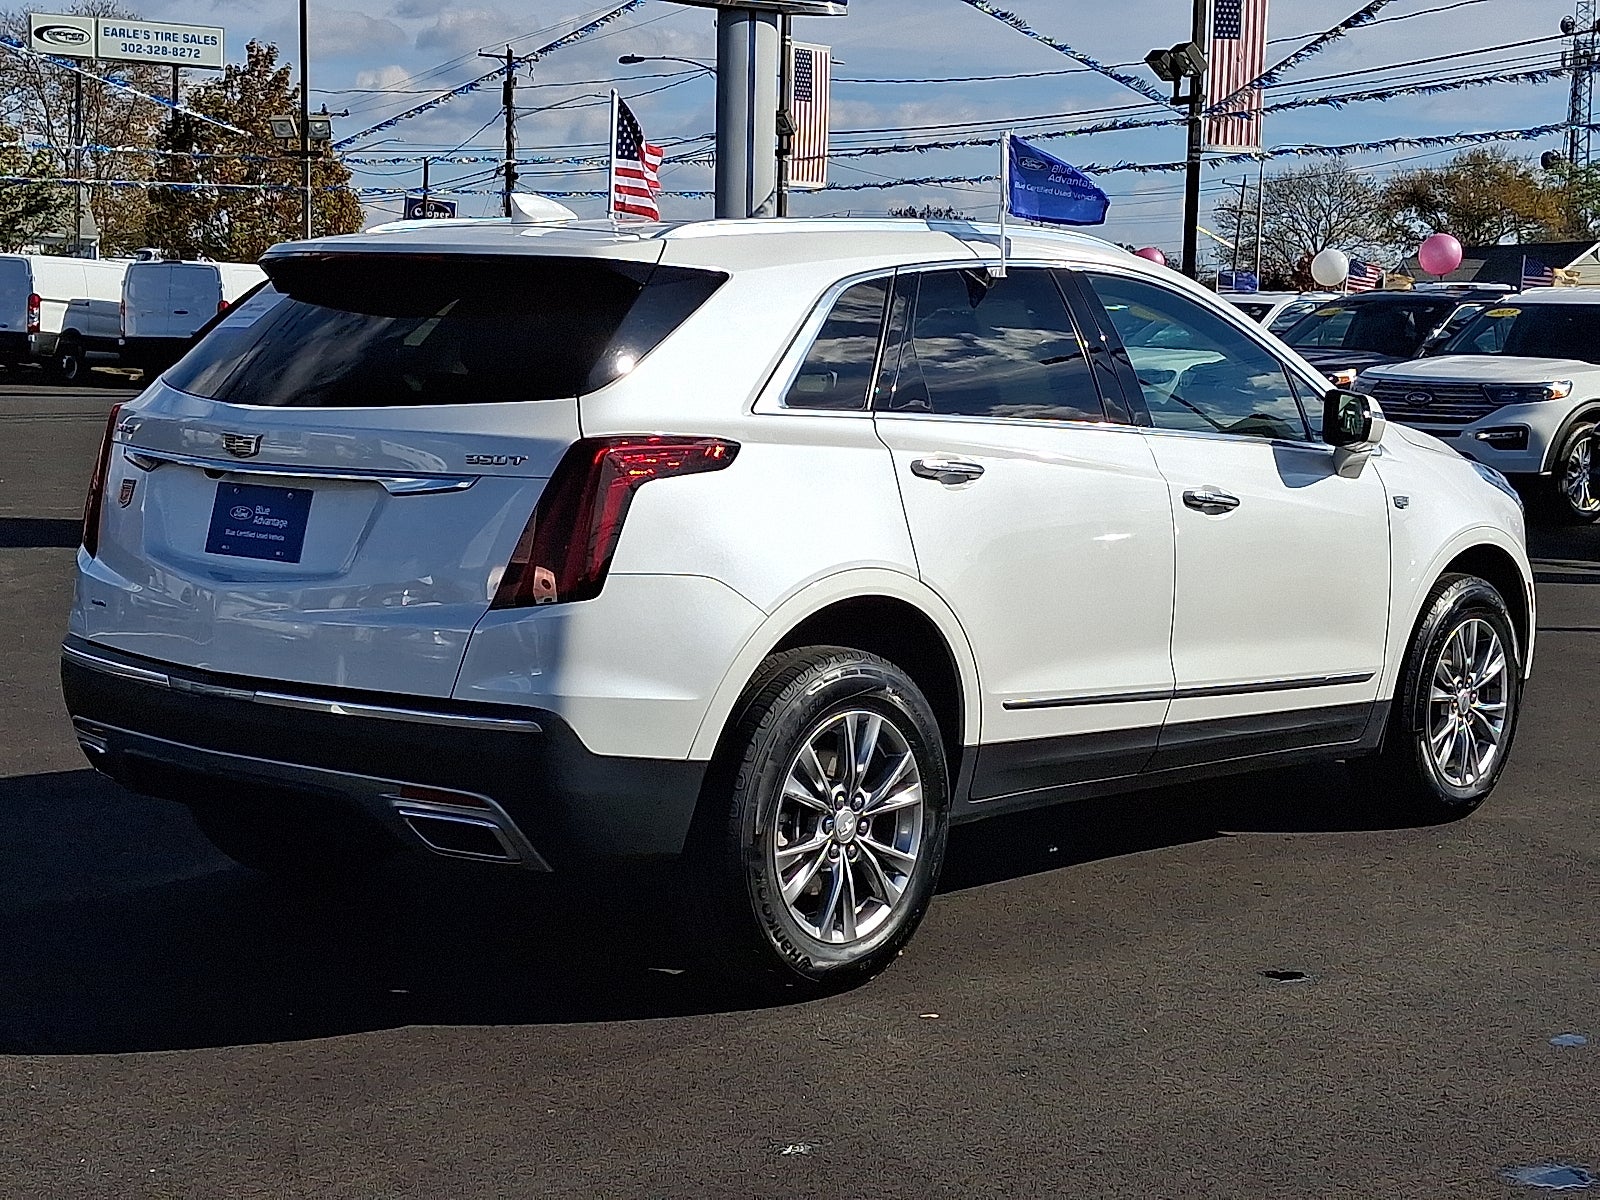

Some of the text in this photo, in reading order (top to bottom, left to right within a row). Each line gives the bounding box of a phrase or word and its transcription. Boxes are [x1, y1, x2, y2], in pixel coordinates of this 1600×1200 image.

[103, 26, 218, 46] EARLE'S TIRE SALES
[120, 42, 201, 59] 302-328-8272
[1051, 164, 1073, 175] Blue
[1054, 188, 1072, 198] Used
[465, 454, 529, 466] 350T
[255, 505, 271, 515] Blue
[252, 515, 288, 529] Advantage
